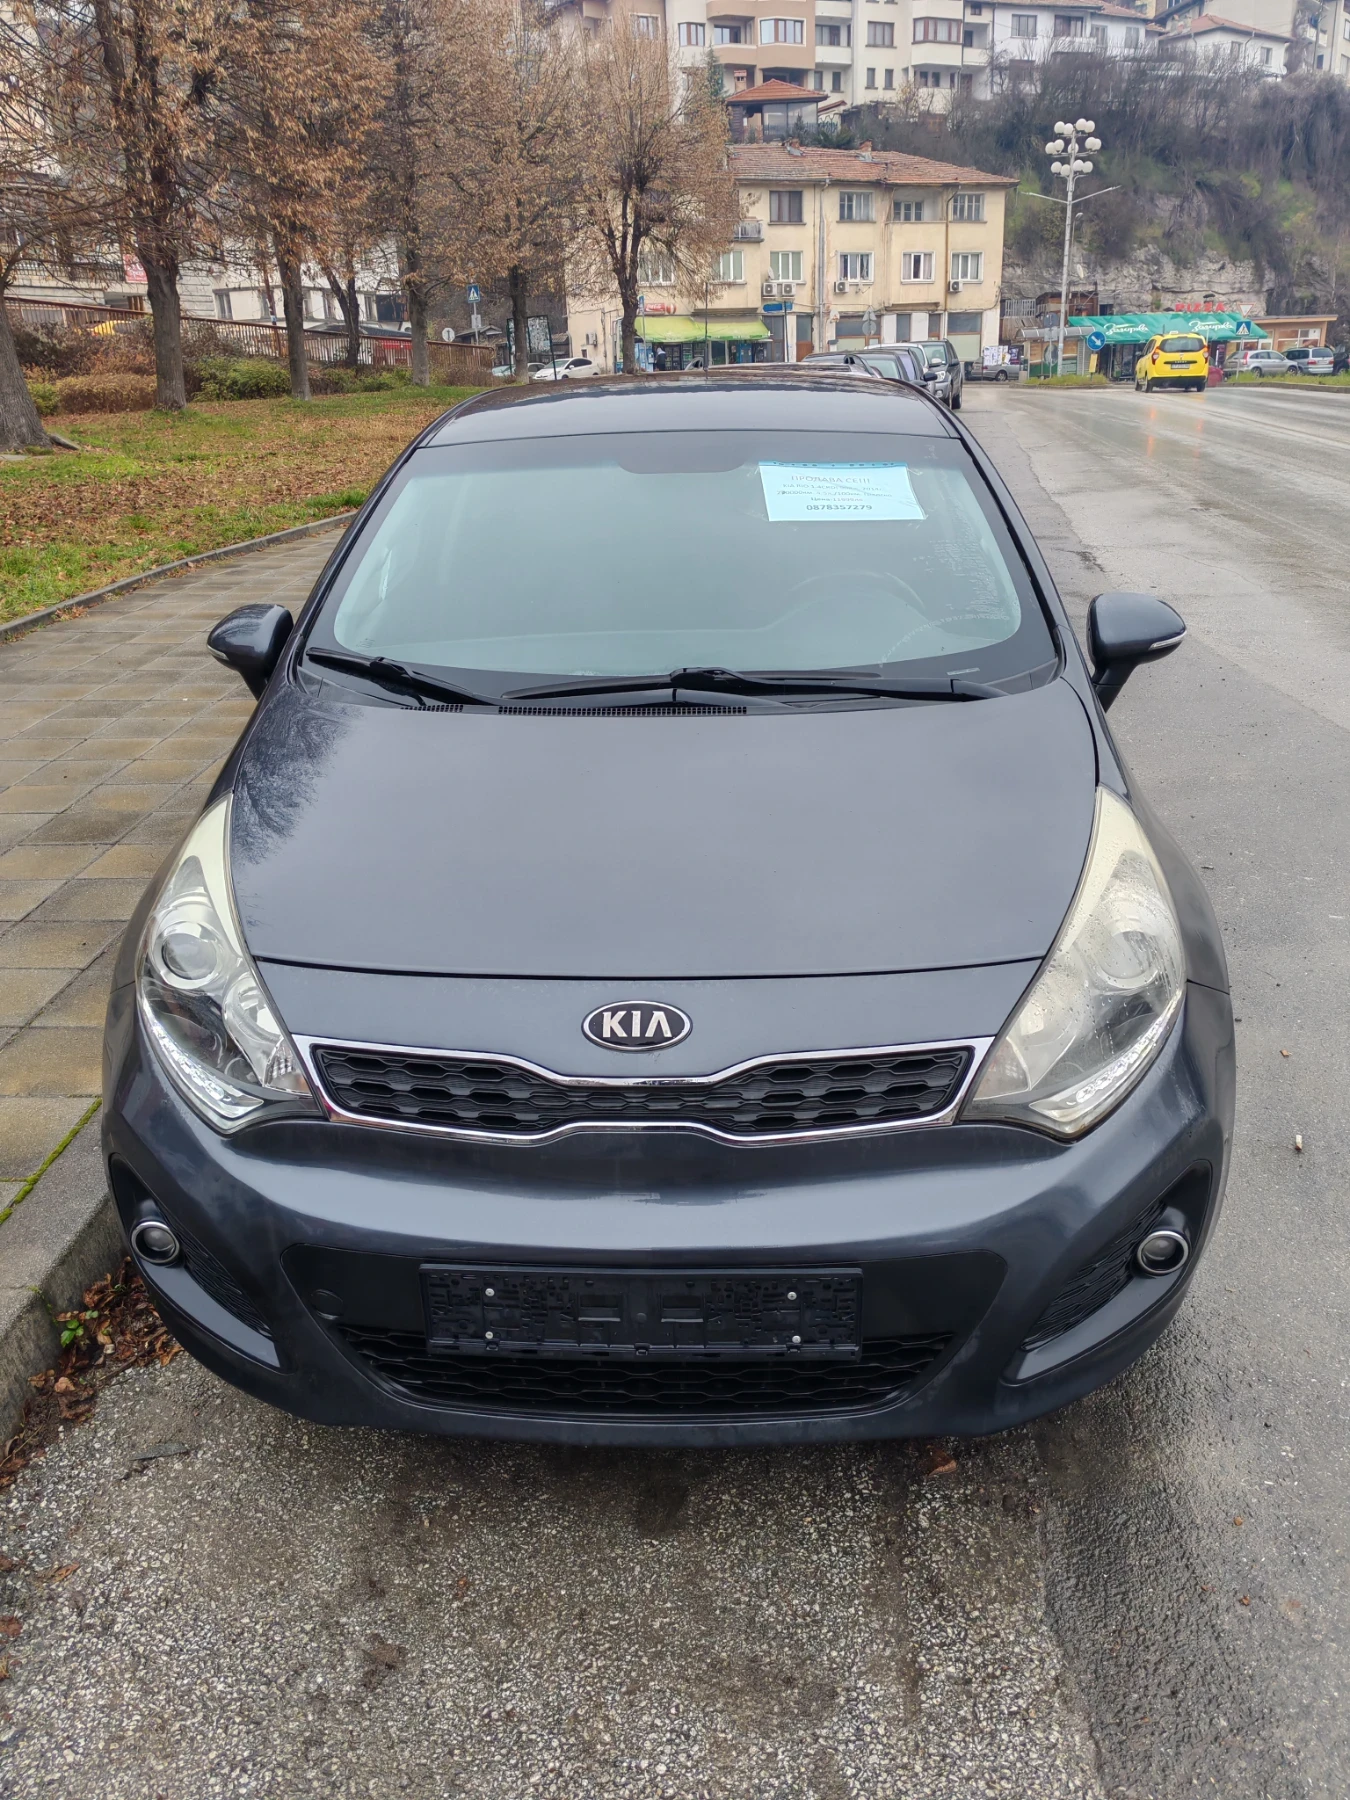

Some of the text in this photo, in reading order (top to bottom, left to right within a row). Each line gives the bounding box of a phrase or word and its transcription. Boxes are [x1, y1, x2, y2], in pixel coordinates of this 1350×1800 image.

[1175, 302, 1226, 312] PIZZA
[791, 475, 843, 484] ПРОДАВА
[602, 1010, 673, 1038] KIA
